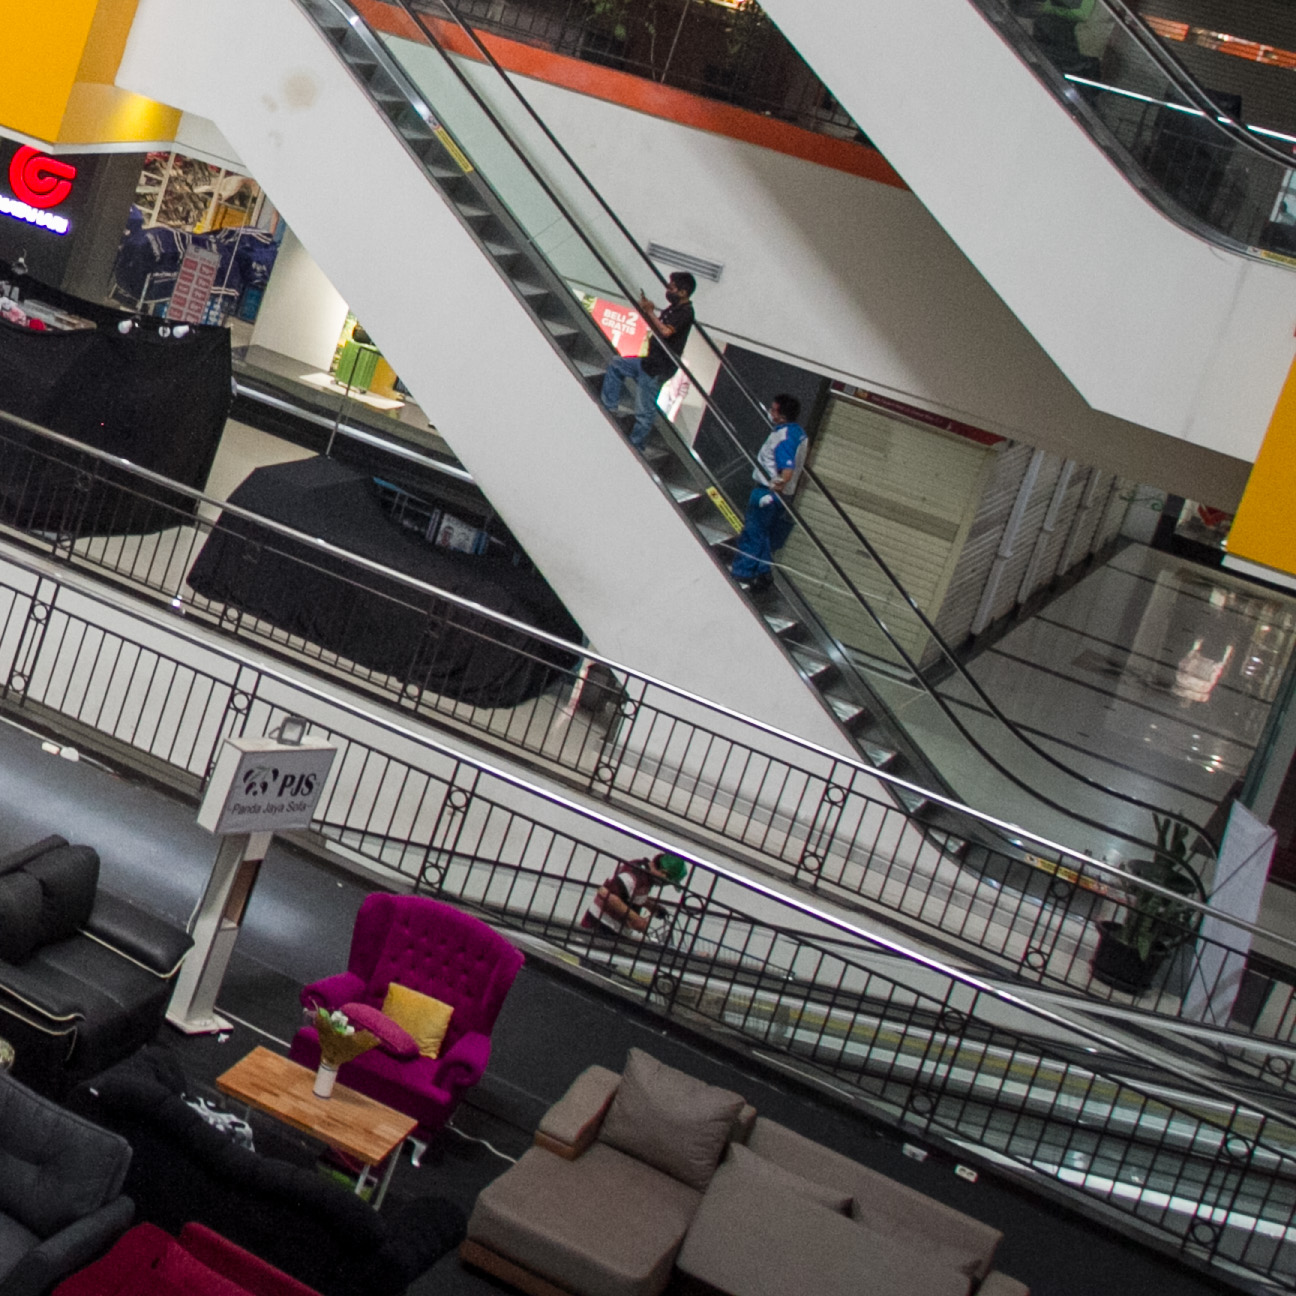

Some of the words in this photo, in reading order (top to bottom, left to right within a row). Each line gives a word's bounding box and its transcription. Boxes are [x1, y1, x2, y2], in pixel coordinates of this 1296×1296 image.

[601, 317, 636, 336] GRATIS
[603, 308, 627, 323] BELI
[625, 311, 639, 327] 2
[611, 329, 622, 348] 1
[277, 772, 317, 797] PJS
